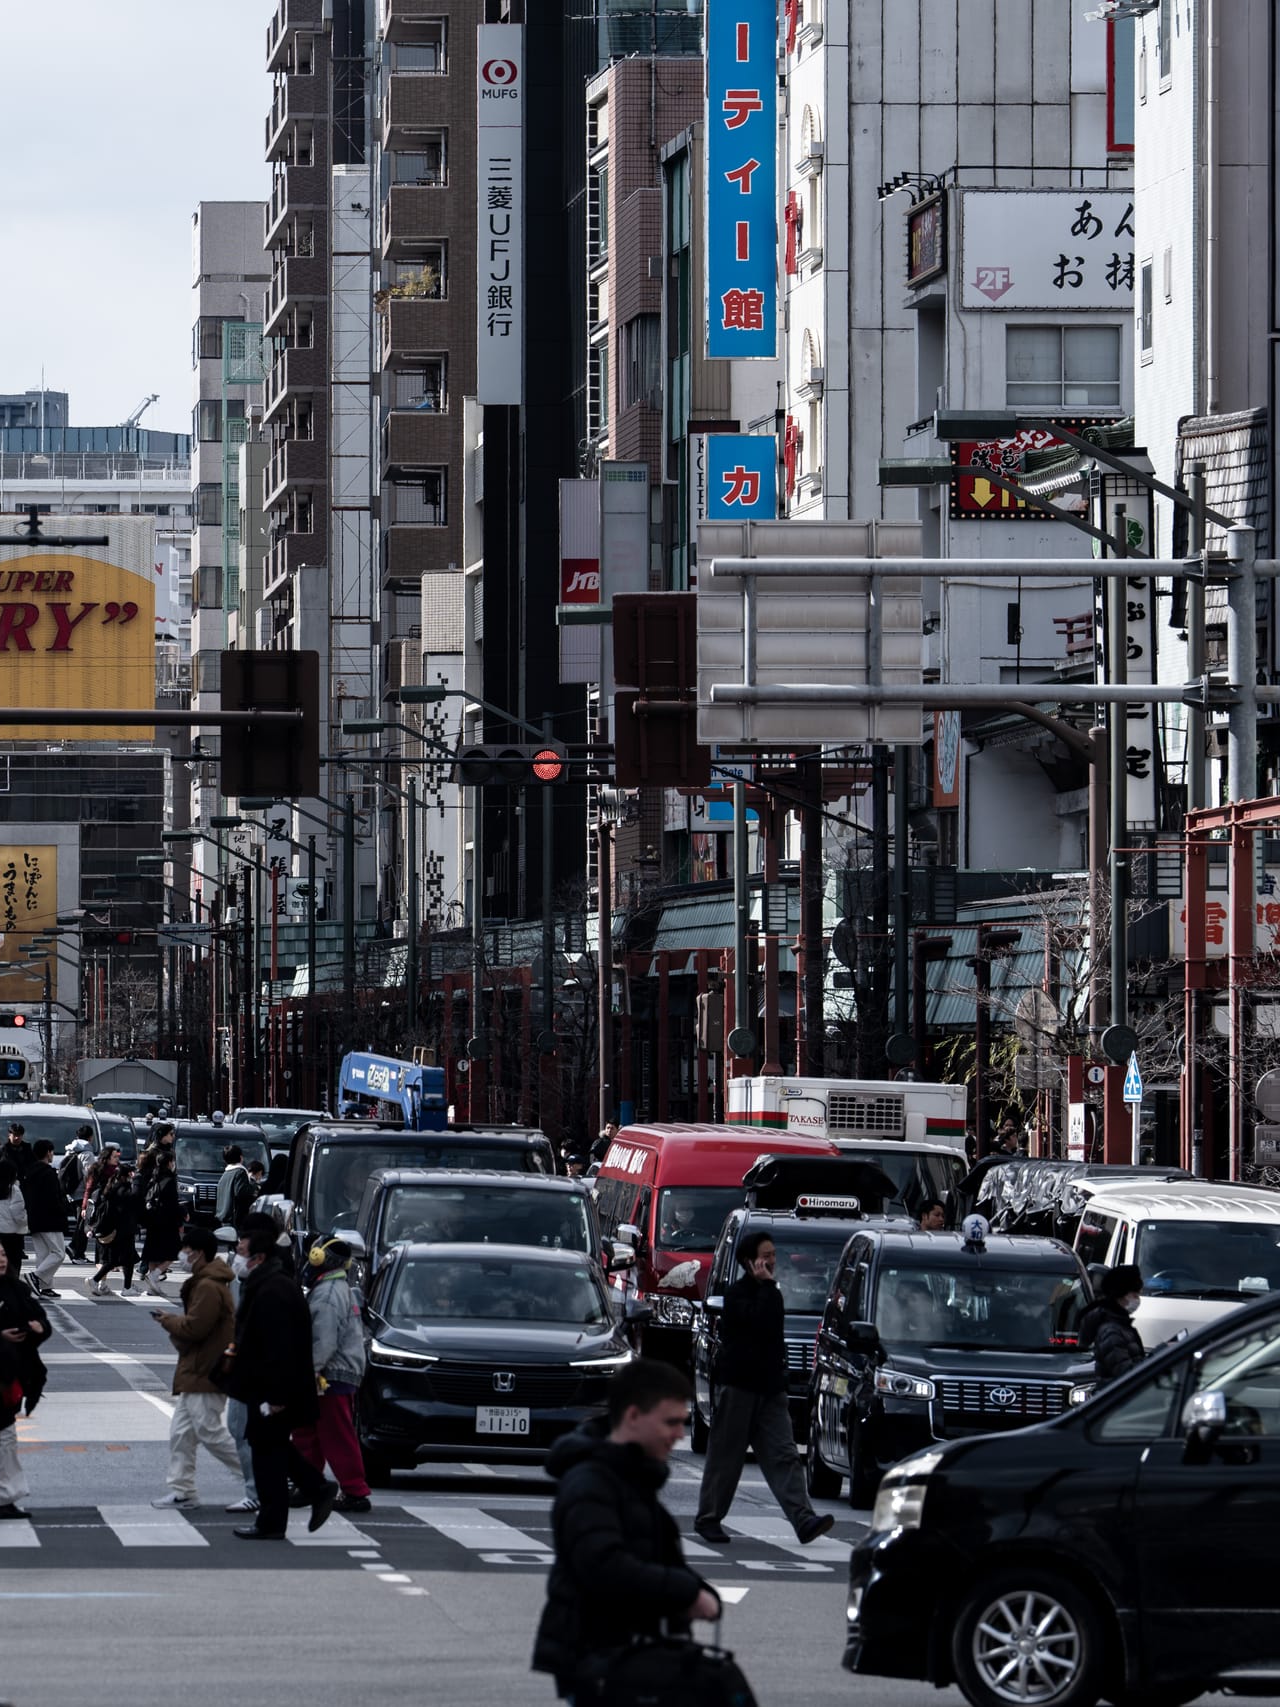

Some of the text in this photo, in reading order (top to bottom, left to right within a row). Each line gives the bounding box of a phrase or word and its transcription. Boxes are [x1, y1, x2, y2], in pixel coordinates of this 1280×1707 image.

[481, 89, 517, 99] MUFG
[487, 158, 513, 337] 三菱UFJ銀行
[979, 270, 1009, 290] 2F
[721, 465, 761, 507] カ
[566, 571, 600, 593] JTB
[23, 852, 42, 911] にっぽんに
[2, 861, 18, 931] うまいもの
[788, 1115, 825, 1125] TAKASE
[808, 1197, 856, 1208] Hinomaru
